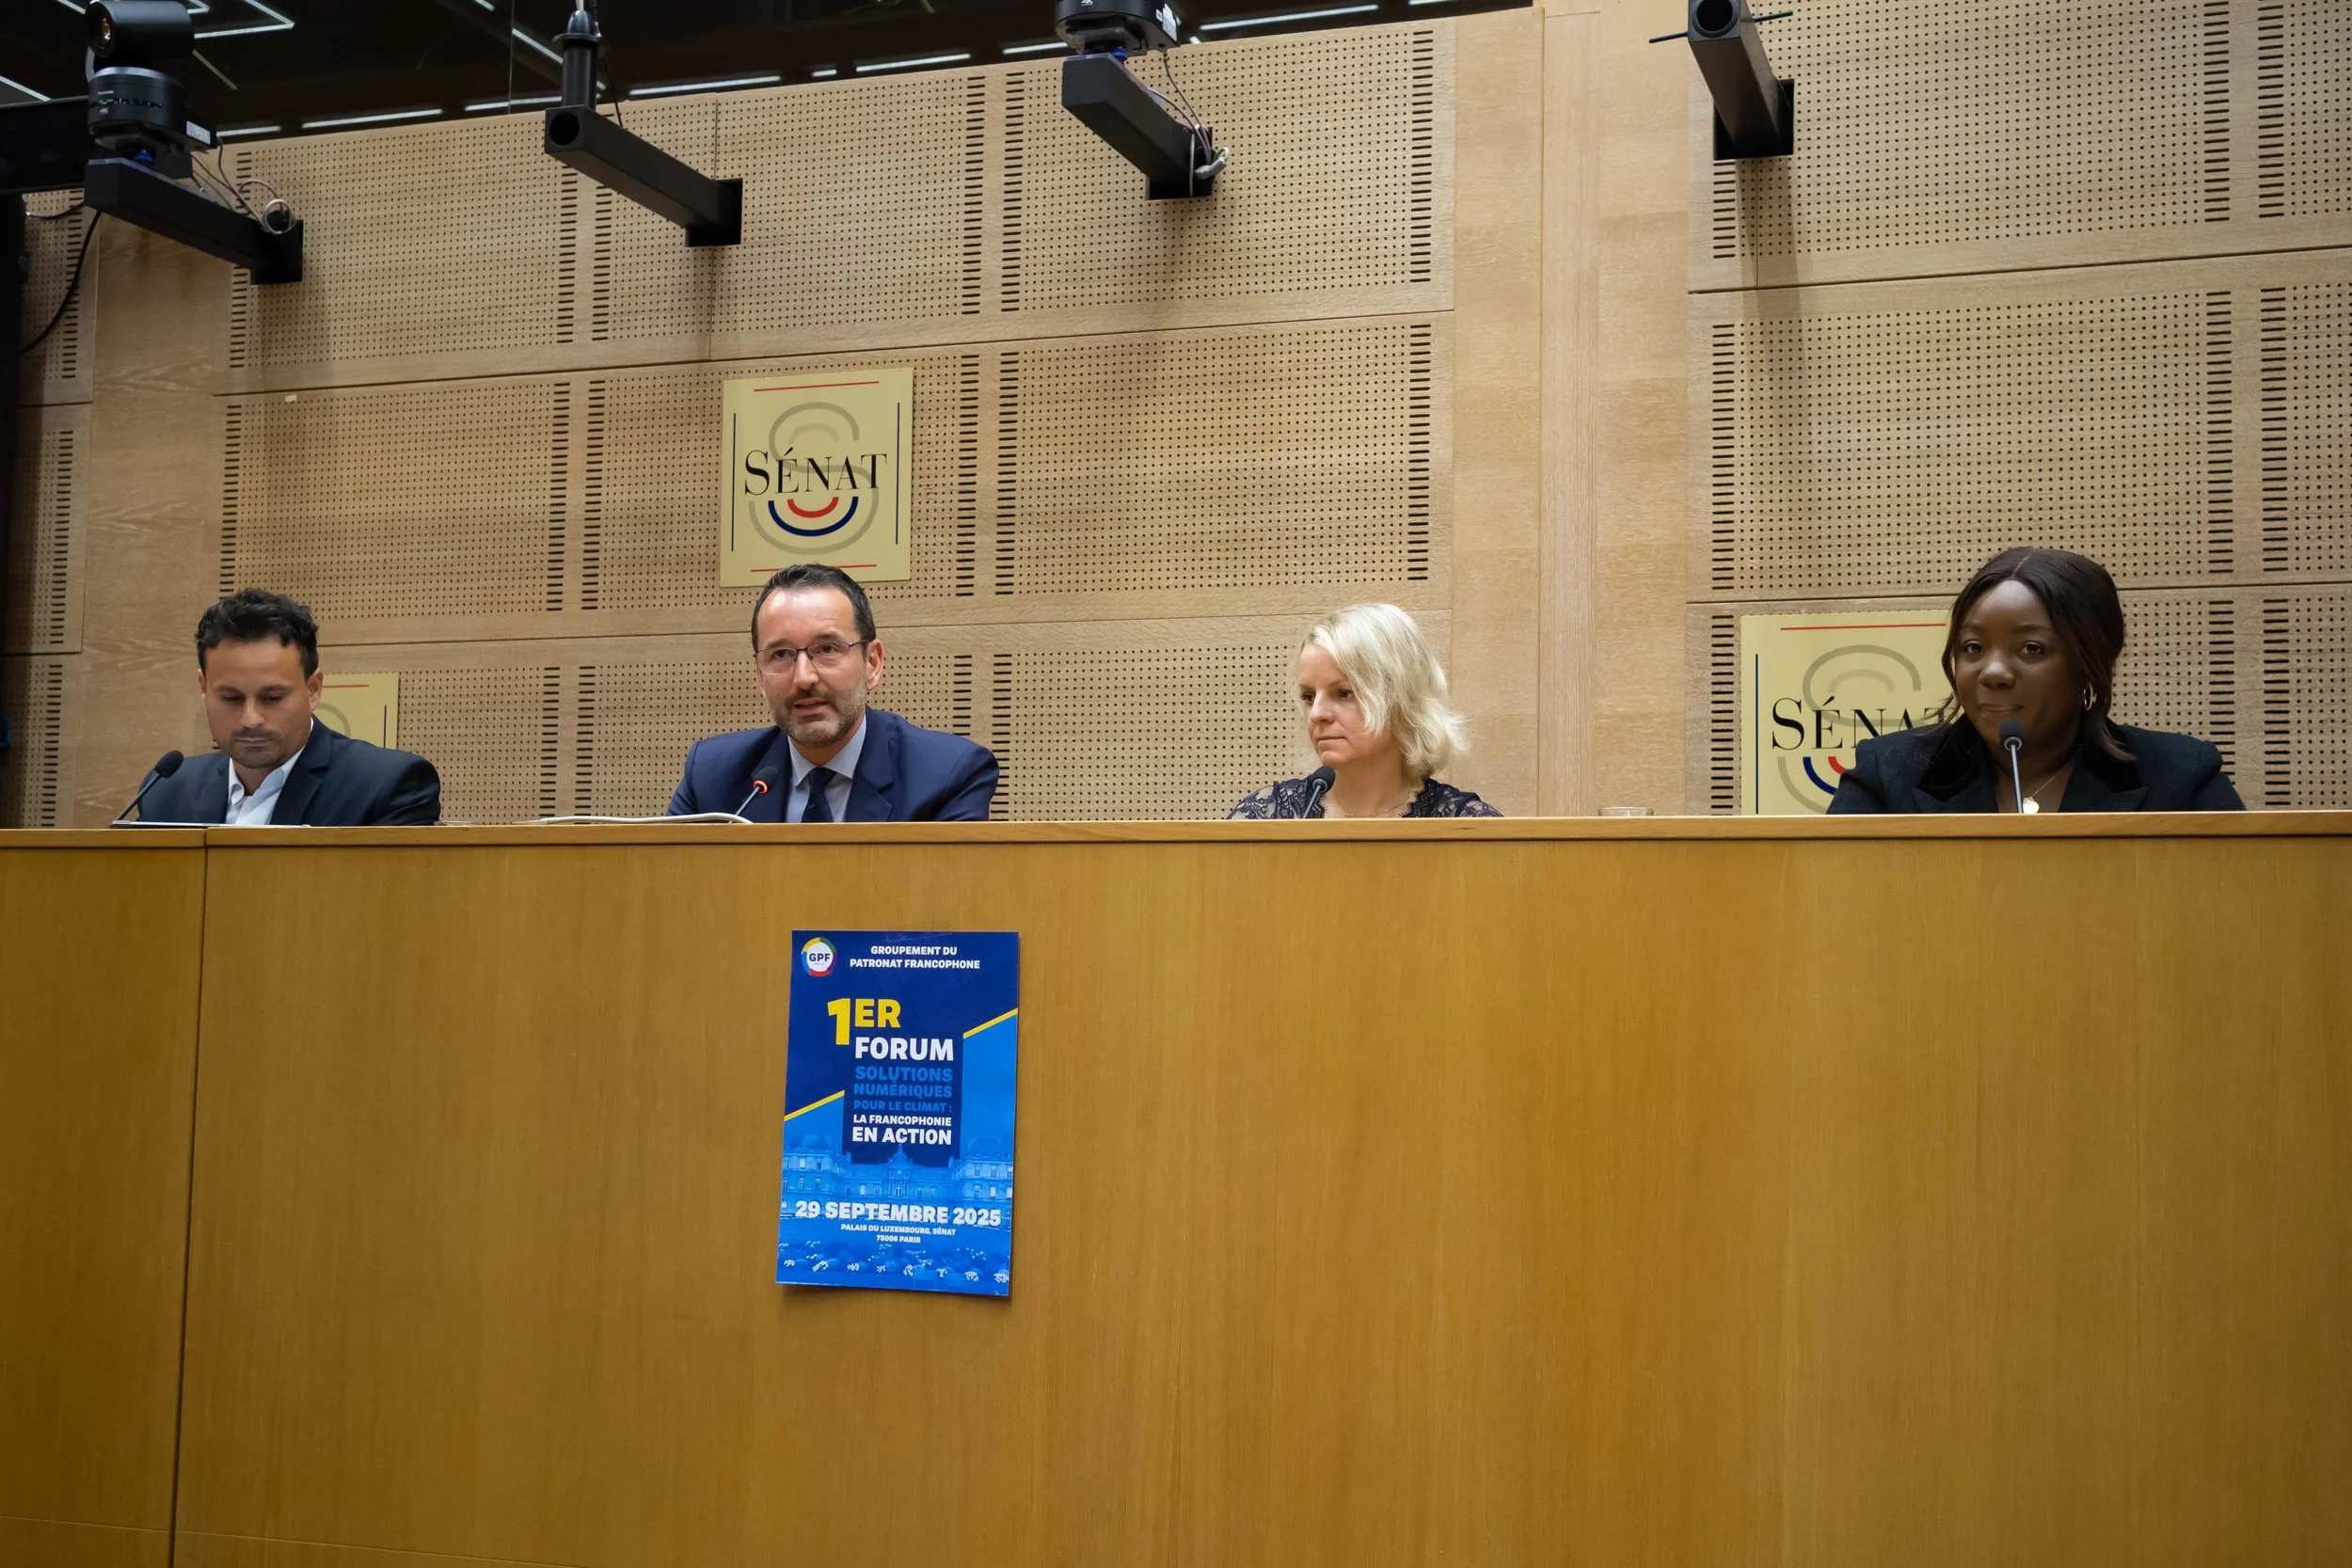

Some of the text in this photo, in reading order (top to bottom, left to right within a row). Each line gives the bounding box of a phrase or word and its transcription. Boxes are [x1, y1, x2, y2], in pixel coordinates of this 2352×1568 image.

[744, 447, 887, 496] SÉNAT
[809, 953, 831, 962] GPF
[870, 945, 958, 956] GROUPEMENT DU
[850, 958, 980, 969] PATRONAT FRANCOPHONE
[827, 998, 901, 1045] 1ER
[854, 1037, 954, 1061] FORUM
[854, 1066, 953, 1082] SOLUTIONS
[853, 1081, 952, 1099] NUMÉRIQUES
[853, 1100, 885, 1110] POUR
[888, 1101, 902, 1111] LE
[904, 1101, 946, 1112] CLIMAT
[853, 1114, 952, 1126] LA FRANCOPHONIE
[852, 1127, 952, 1145] EN ACTION
[795, 1200, 1001, 1227] 29 SEPTEMBRE 2025
[880, 1226, 931, 1235] LUXEMBOURG,
[932, 1227, 957, 1235] SÉNAT
